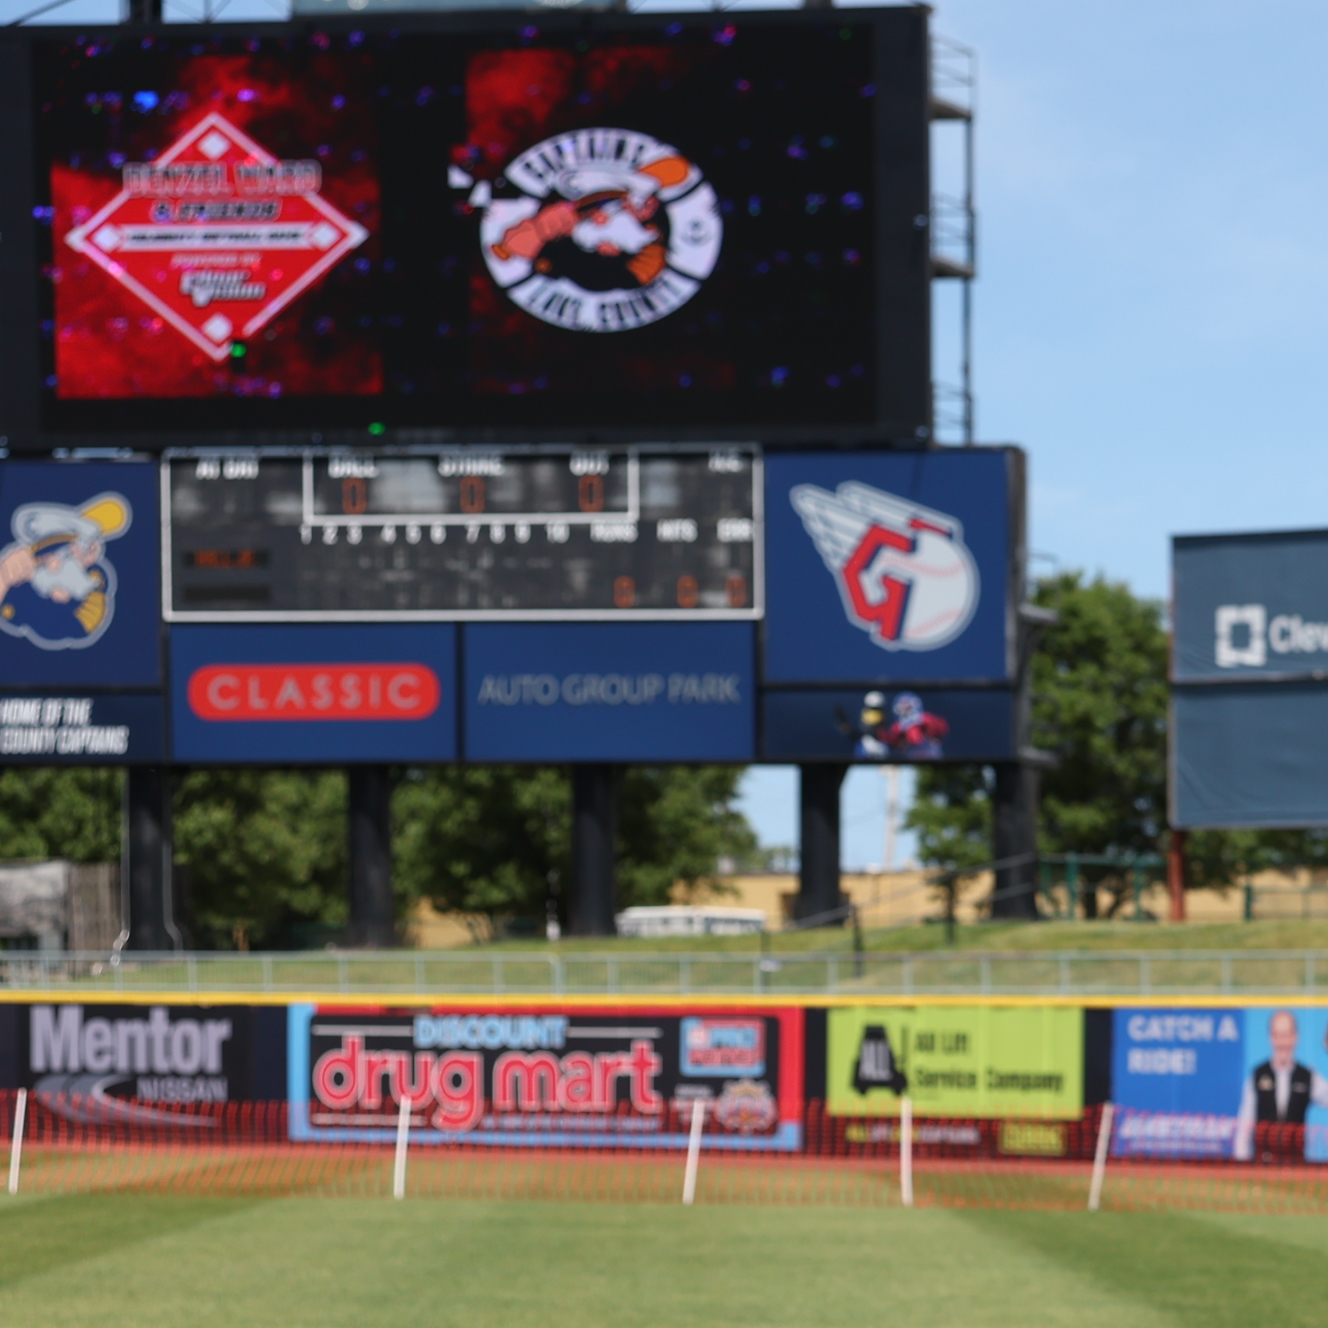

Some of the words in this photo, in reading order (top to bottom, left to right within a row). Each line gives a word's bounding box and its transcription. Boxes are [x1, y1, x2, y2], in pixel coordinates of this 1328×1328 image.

[299, 524, 313, 545] 1
[322, 524, 339, 545] 2
[207, 673, 422, 711] CLASSIC
[477, 672, 560, 706] AUTO
[561, 672, 666, 706] GROUP
[667, 671, 743, 705] PARK
[29, 1004, 234, 1074] Mentor
[412, 1014, 570, 1049] DISCOUNT
[1126, 1014, 1214, 1042] CATCH
[1216, 1014, 1240, 1041] A
[1126, 1047, 1198, 1076] RIDE!
[136, 1075, 229, 1103] NISSAN
[312, 1031, 486, 1132] drug
[492, 1038, 663, 1114] mart
[914, 1067, 978, 1091] Service
